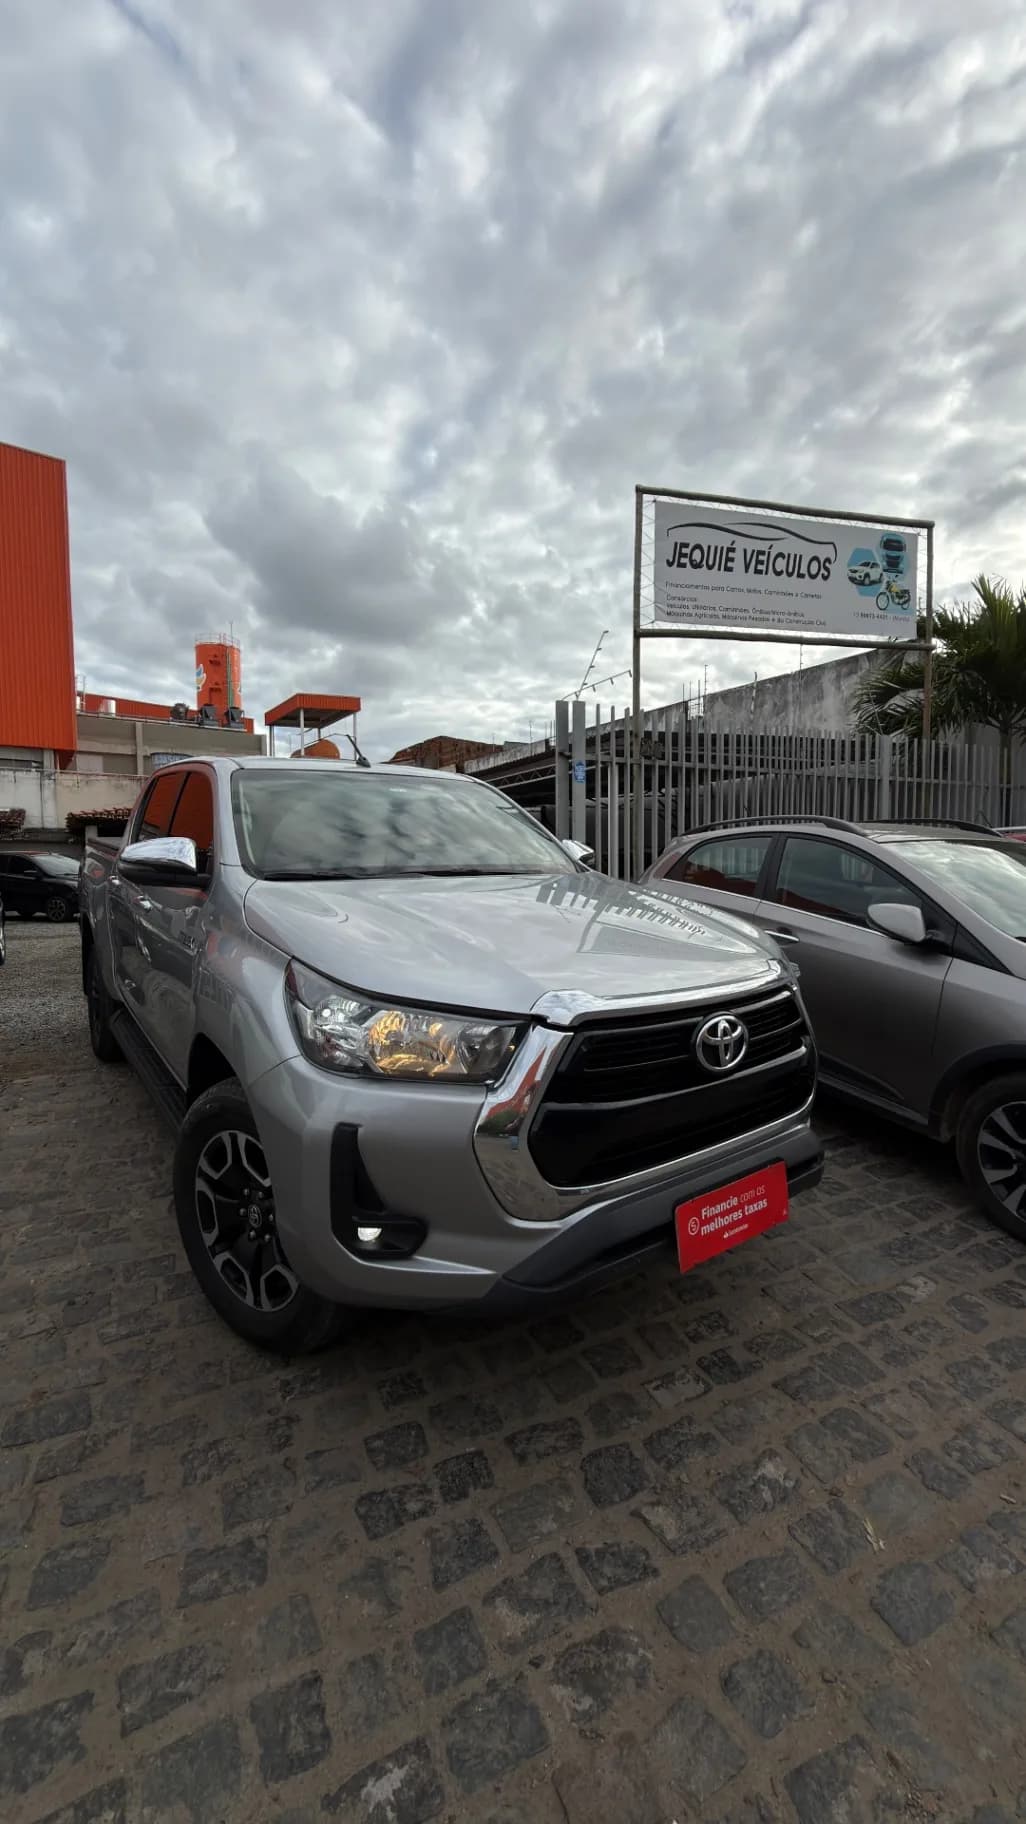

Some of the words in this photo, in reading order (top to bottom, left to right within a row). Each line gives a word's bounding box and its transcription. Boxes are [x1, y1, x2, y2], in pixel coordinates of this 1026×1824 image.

[666, 540, 736, 573] JEQUIÉ
[743, 544, 832, 581] VEÍCULOS
[701, 1196, 738, 1219] Financie
[740, 1189, 755, 1202] com
[701, 1209, 743, 1236] melhores
[744, 1198, 768, 1215] taxas
